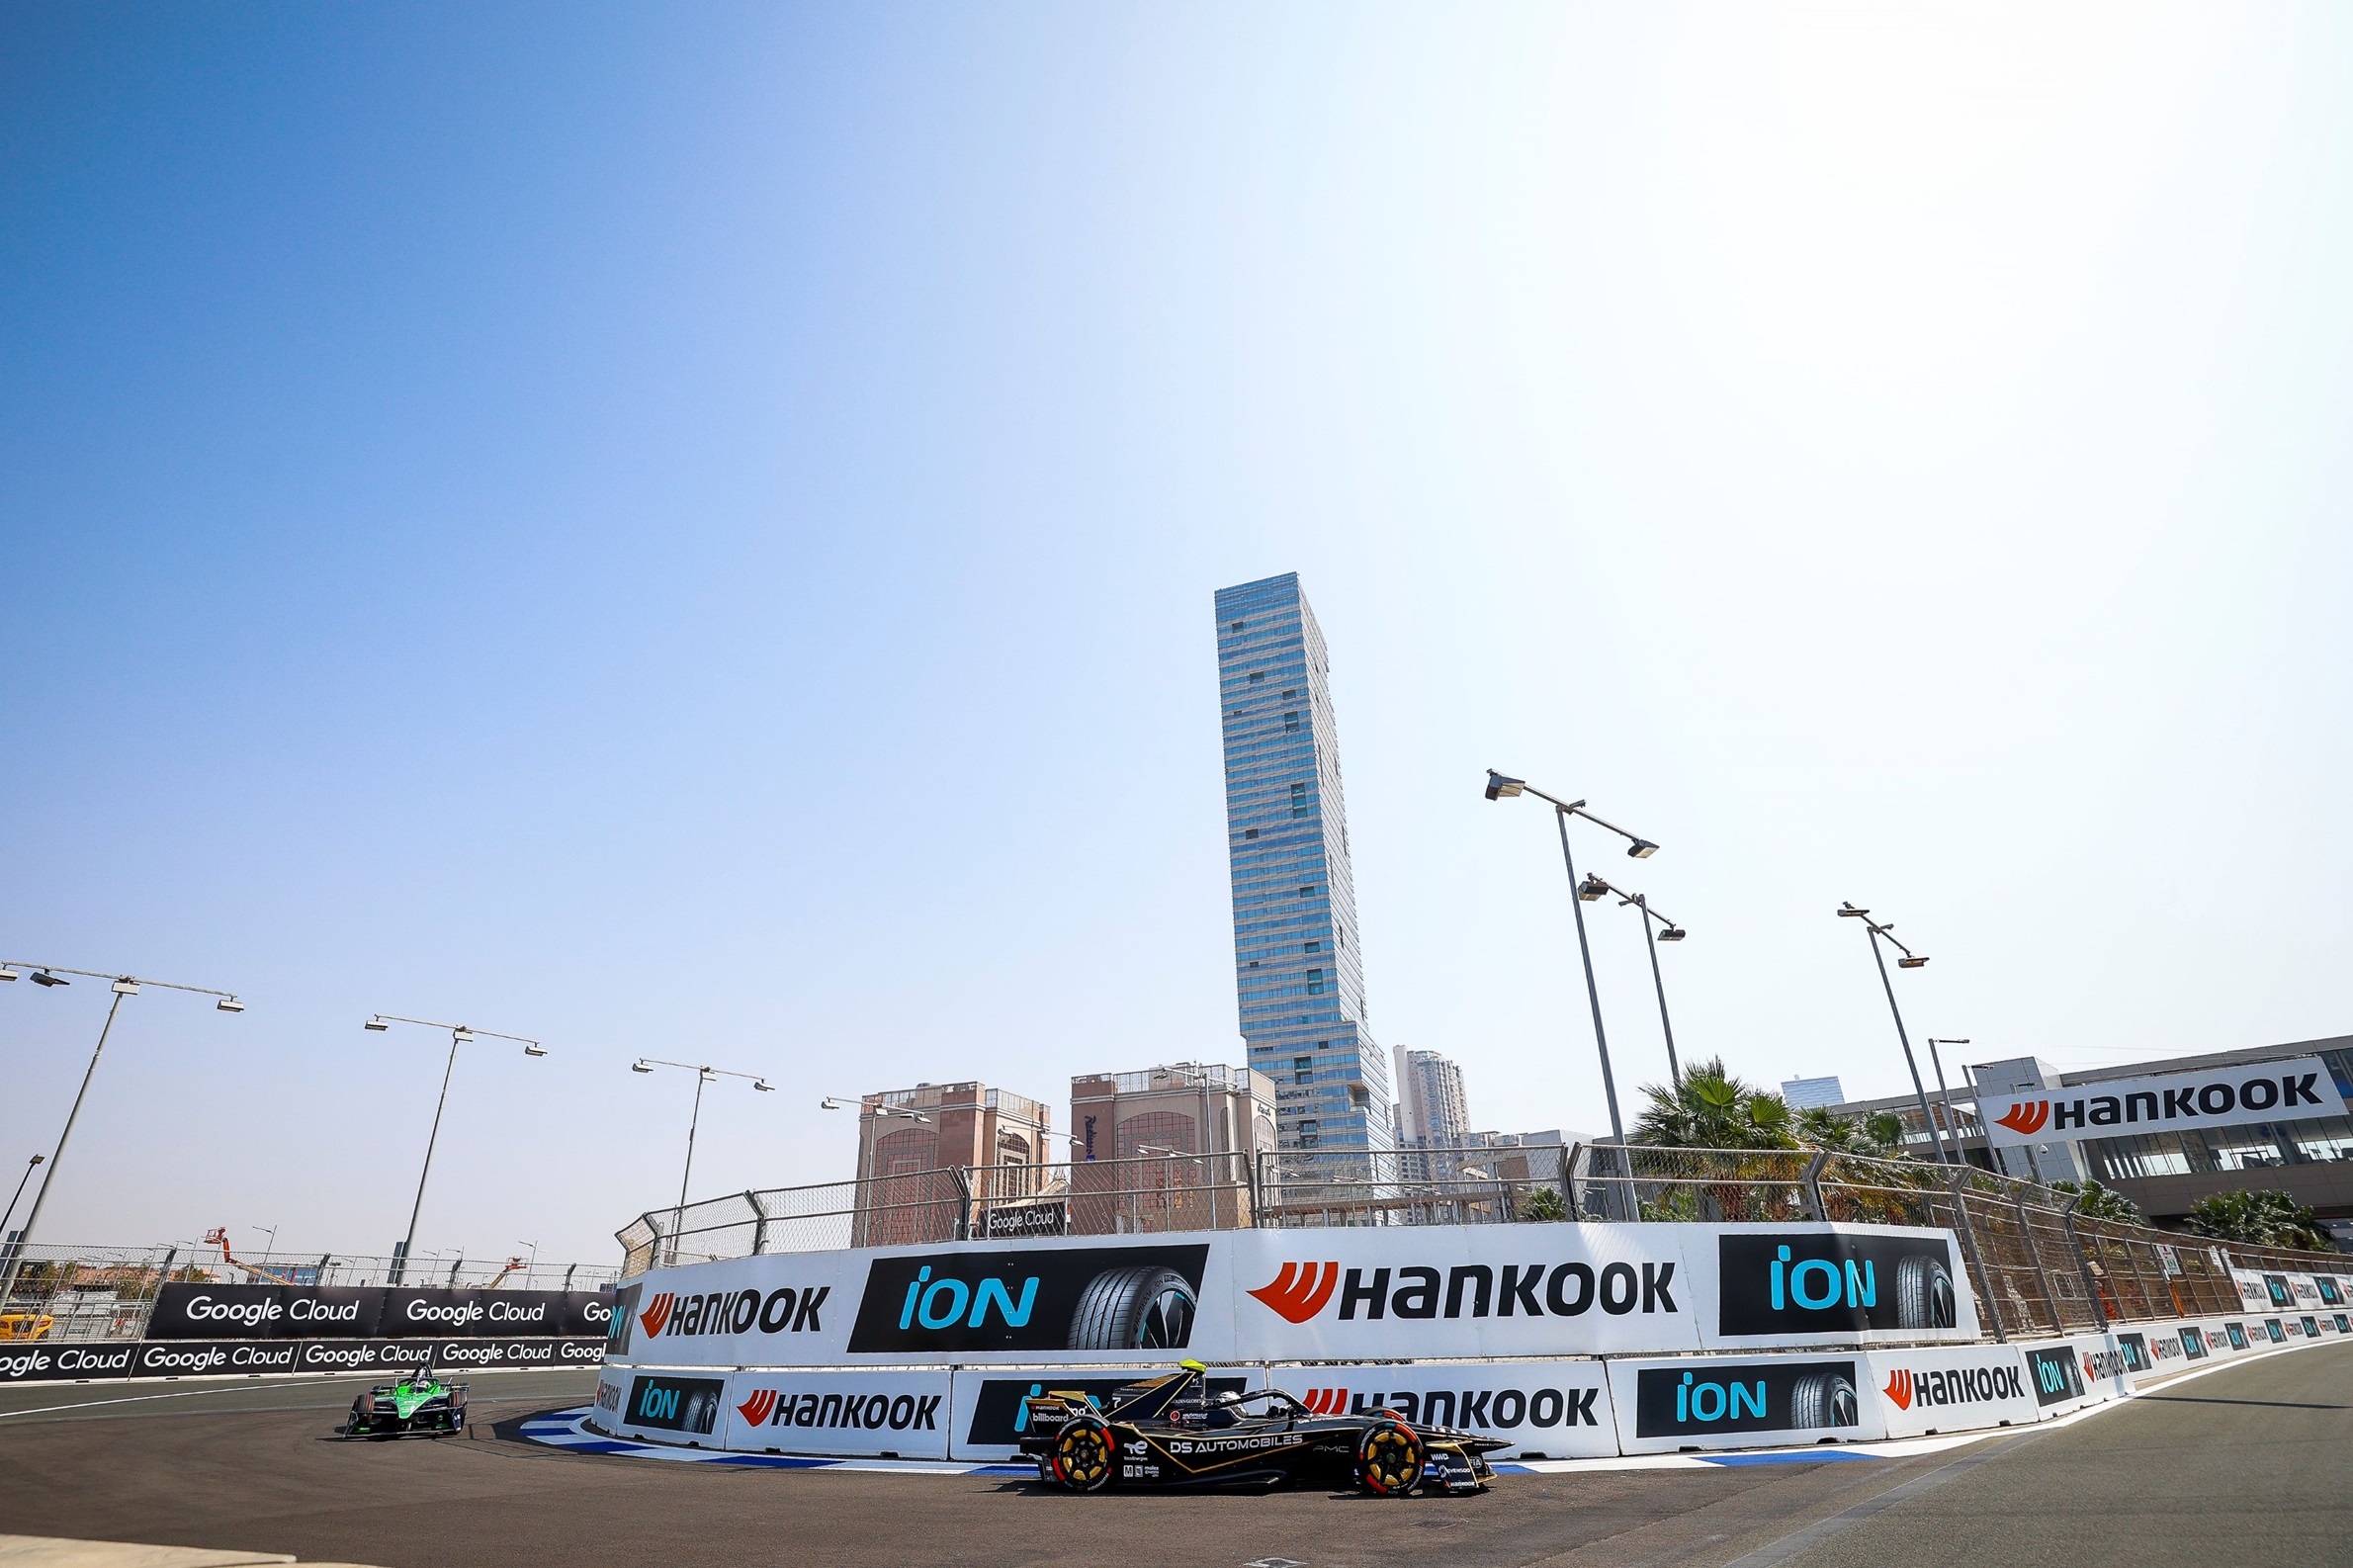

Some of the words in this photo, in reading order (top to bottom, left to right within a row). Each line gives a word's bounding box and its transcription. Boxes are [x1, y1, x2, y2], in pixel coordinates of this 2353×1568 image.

[989, 1211, 1023, 1231] Google
[1025, 1207, 1054, 1226] Cloud
[186, 1295, 283, 1326] Google
[289, 1298, 360, 1320] Cloud
[406, 1298, 483, 1326] Google
[488, 1301, 546, 1321] Cloud
[0, 1350, 50, 1377] ogle
[57, 1349, 131, 1369] Cloud
[143, 1347, 226, 1371] Google
[231, 1347, 294, 1365] Cloud
[305, 1345, 376, 1367] Google
[381, 1345, 432, 1361] Cloud
[442, 1343, 503, 1364] Google
[507, 1344, 552, 1359] Cloud
[561, 1343, 607, 1361] Googl
[1111, 1397, 1121, 1408] 7
[1032, 1413, 1069, 1422] billboard
[1170, 1441, 1192, 1453] DS
[1194, 1435, 1303, 1453] AUTOMOBILES
